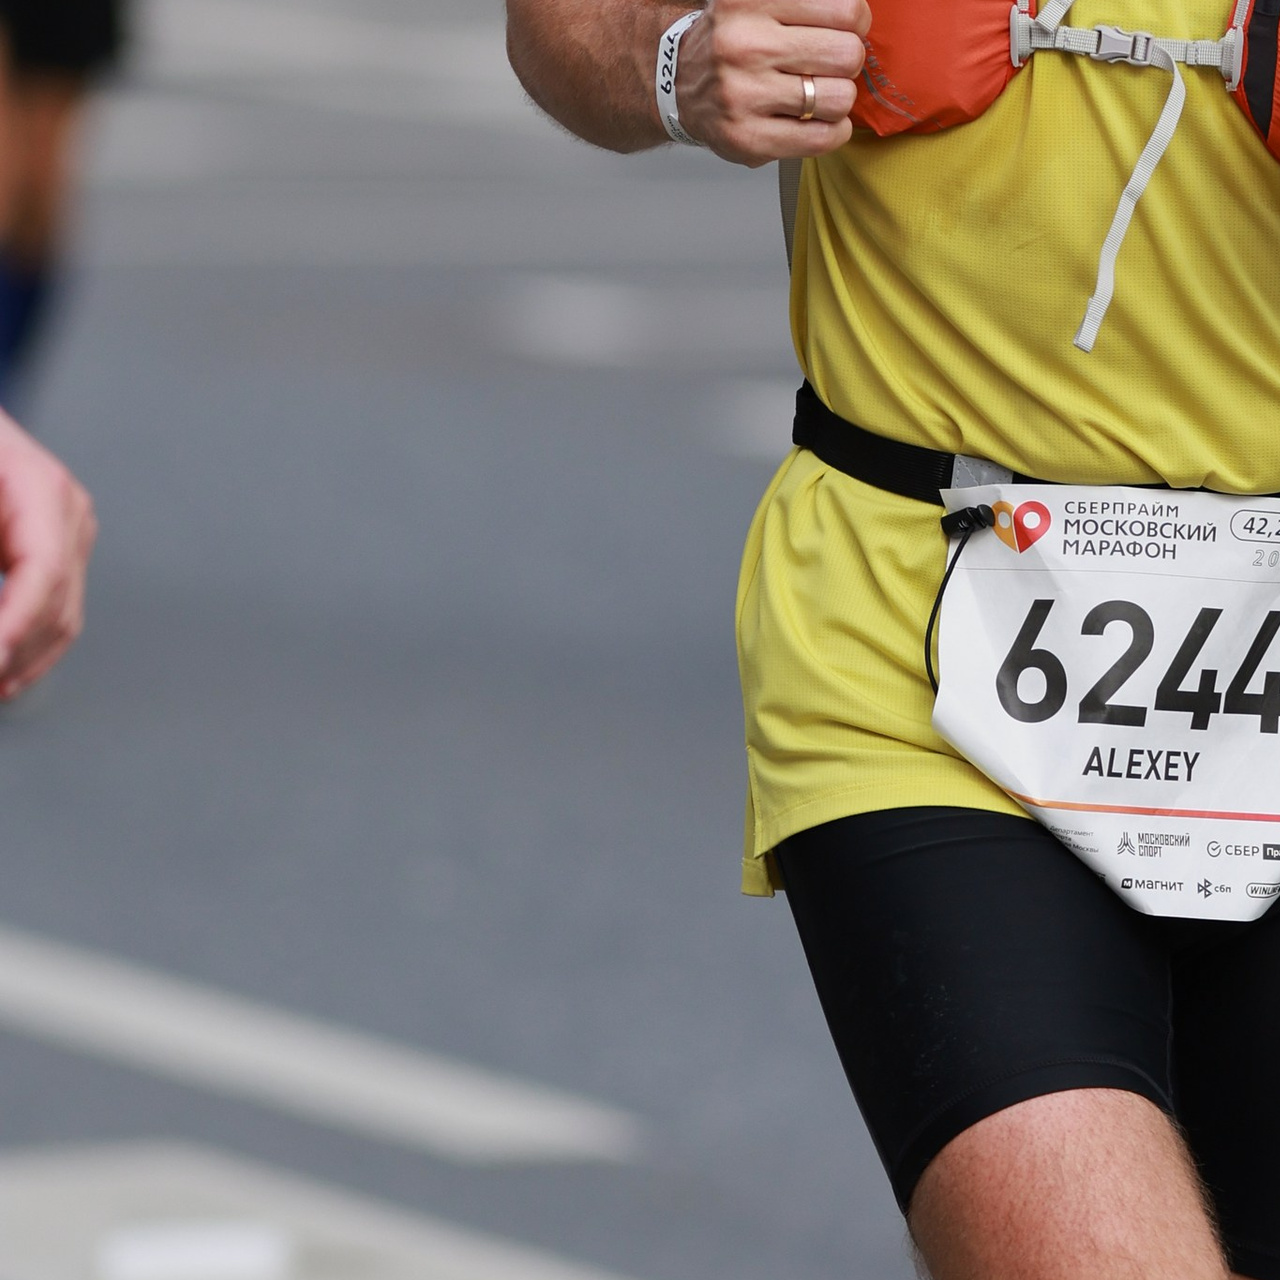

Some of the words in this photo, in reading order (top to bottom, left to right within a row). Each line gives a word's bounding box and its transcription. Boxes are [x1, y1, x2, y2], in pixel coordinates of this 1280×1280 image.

[661, 31, 680, 94] 6244
[1064, 501, 1179, 518] СБЕРПРАЙМ
[1063, 518, 1217, 542] МОСКОВСКИЙ
[1062, 539, 1177, 560] МАРАФОН
[1082, 746, 1200, 782] ALEXEY
[1138, 833, 1190, 847] МОСКОВСКИЙ
[1138, 846, 1163, 858] СПОРТ
[1225, 844, 1260, 857] СБЕР
